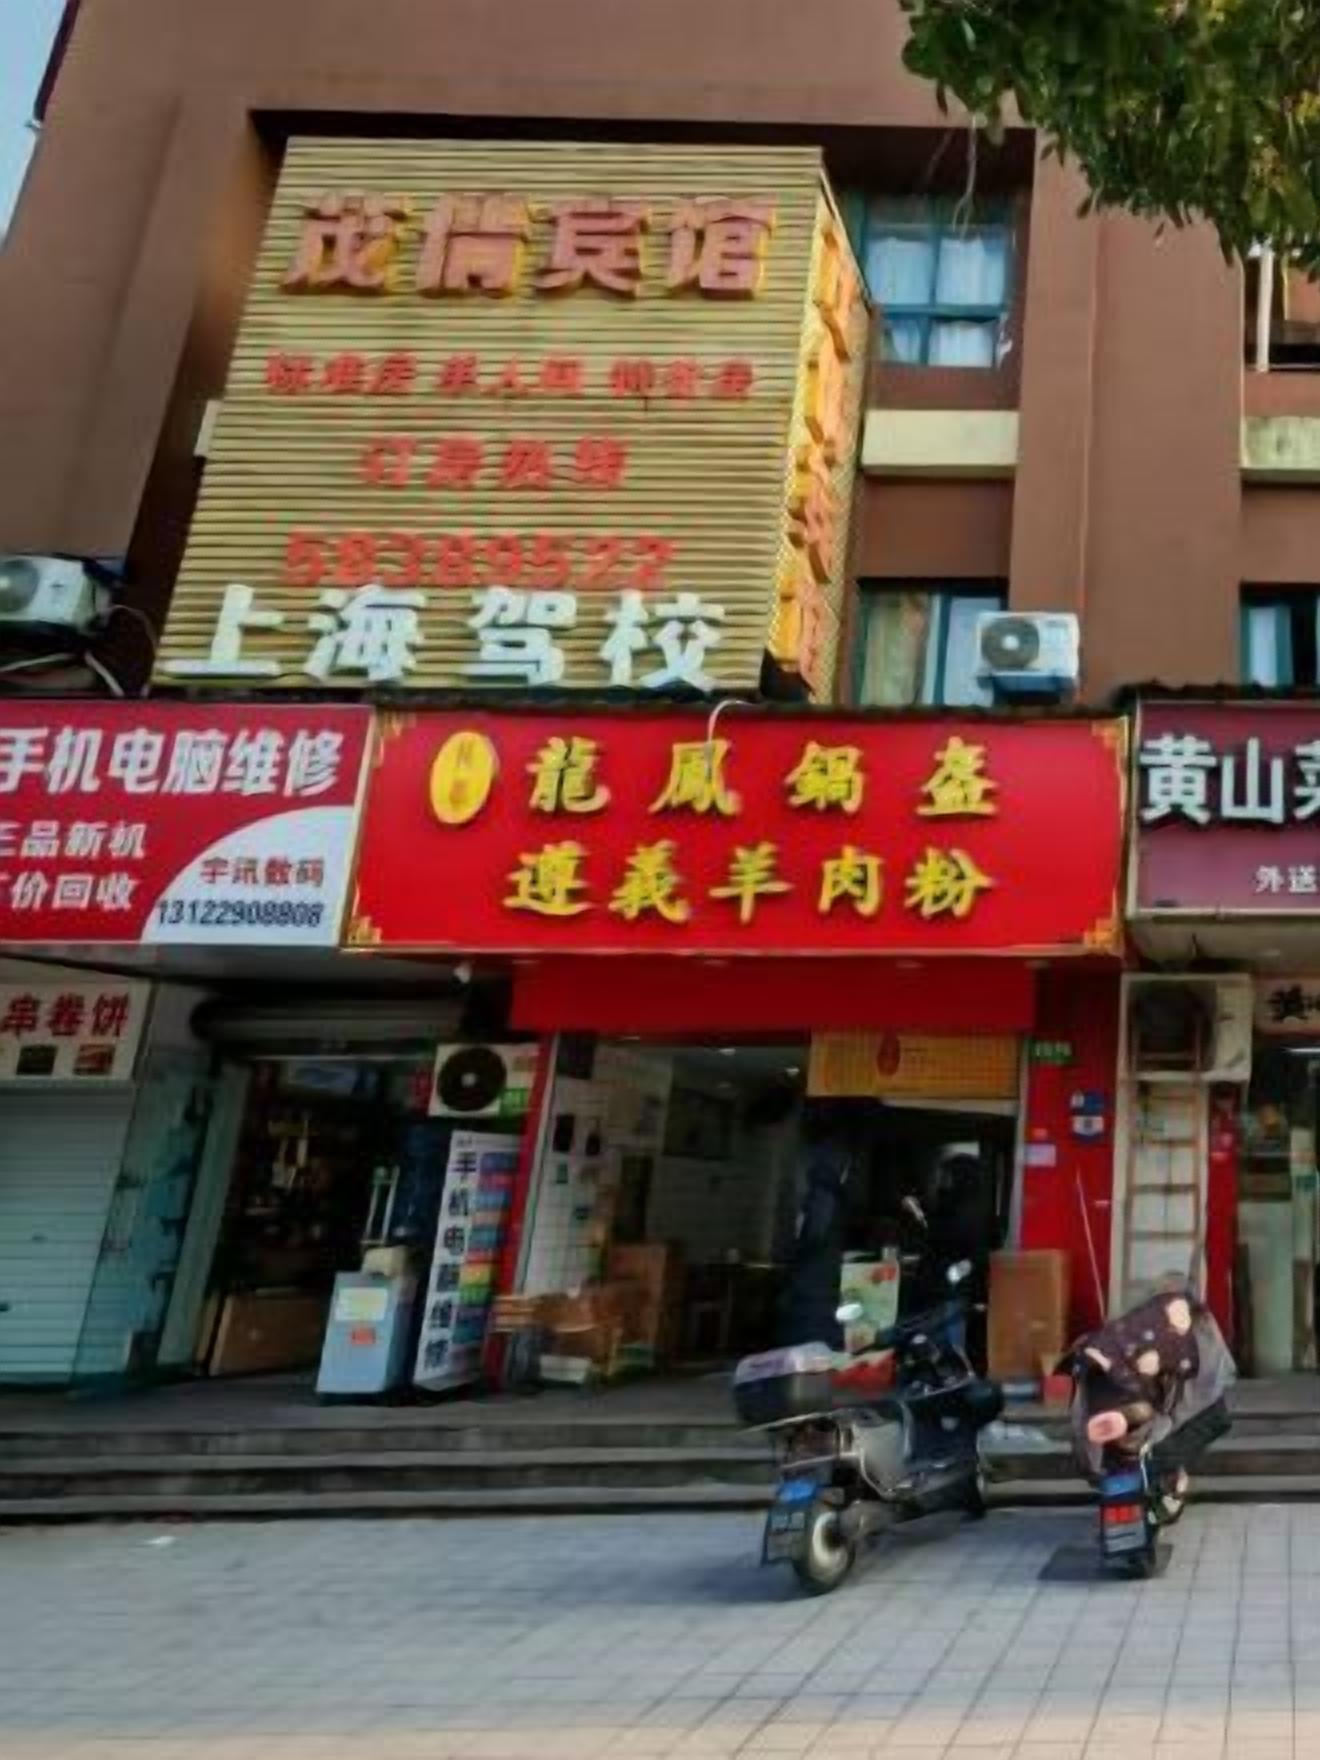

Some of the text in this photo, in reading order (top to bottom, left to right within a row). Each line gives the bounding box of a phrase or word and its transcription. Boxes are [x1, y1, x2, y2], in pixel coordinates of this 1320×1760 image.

[157, 583, 726, 690] 上海驾校
[0, 726, 344, 797] 手机电脑维修
[0, 871, 140, 911] 价回收
[503, 840, 995, 924] 遵義羊肉粉
